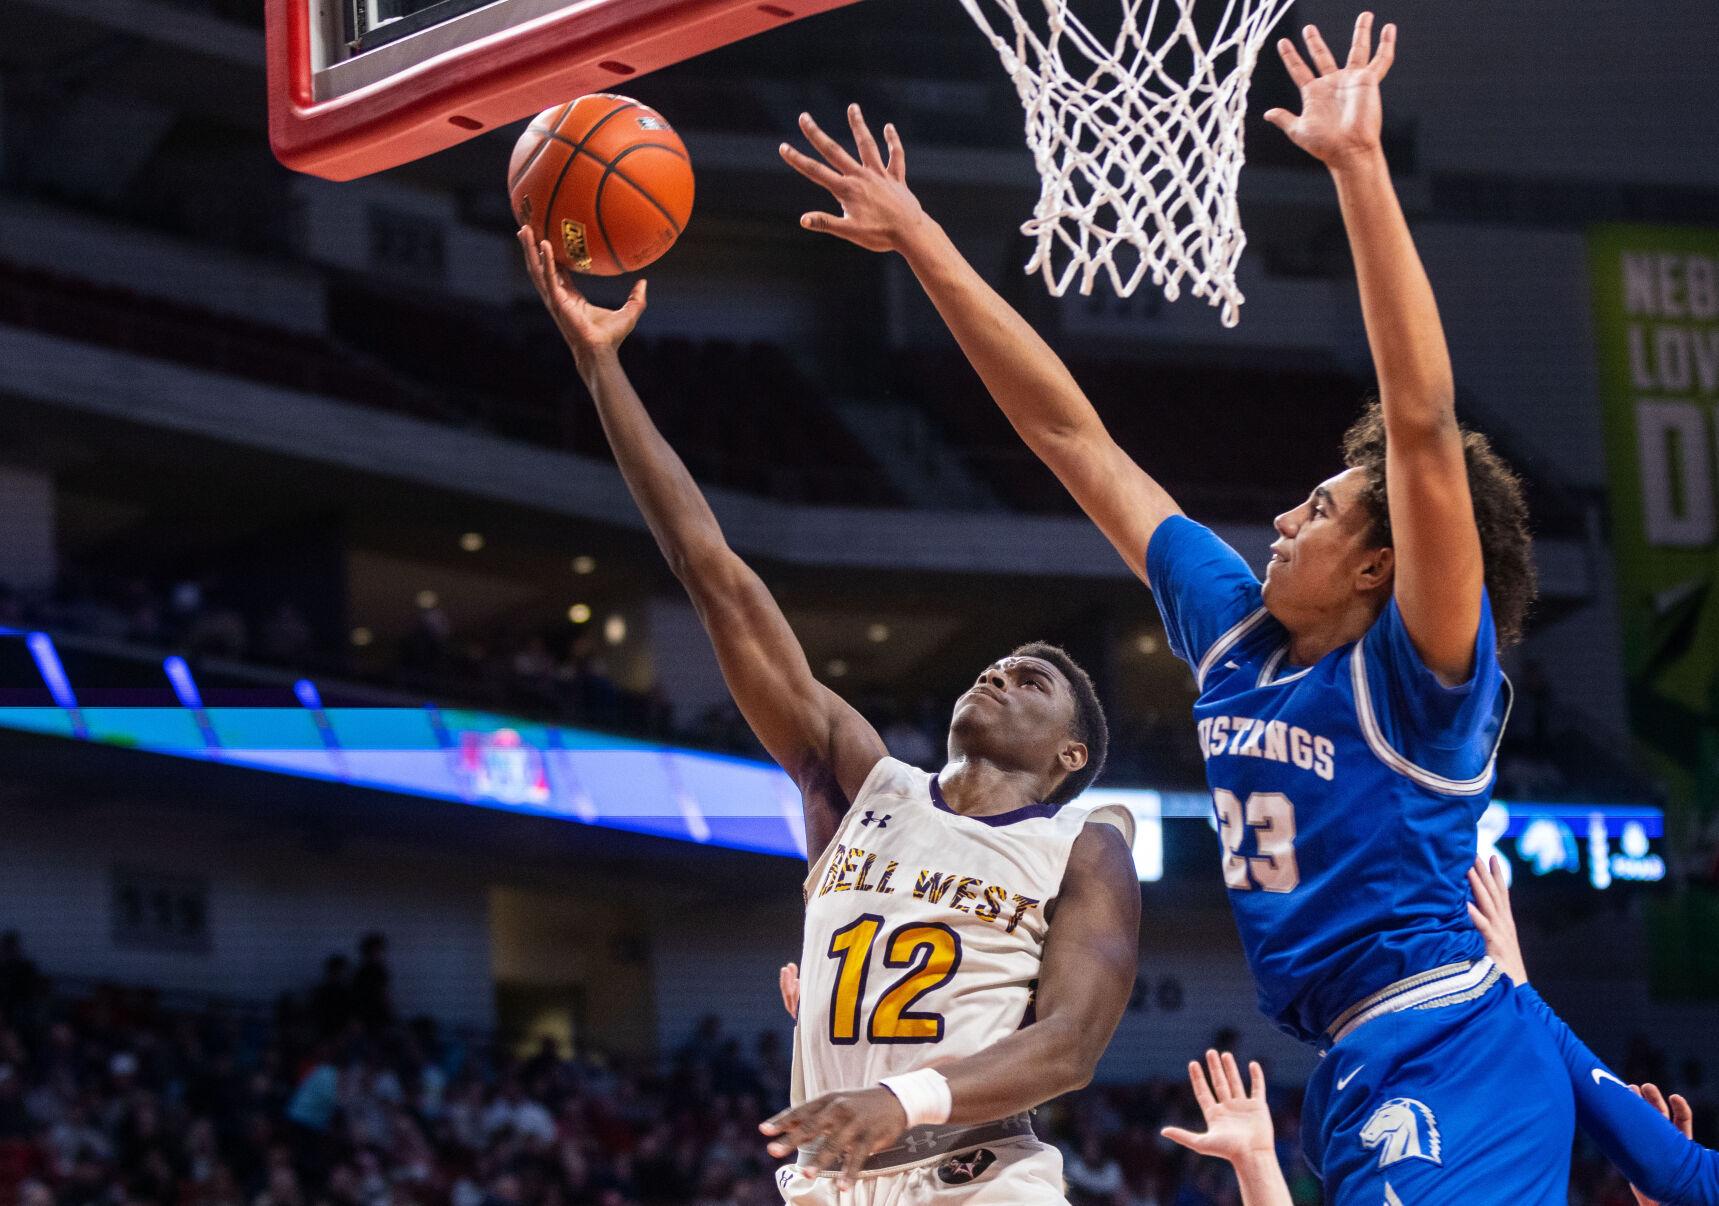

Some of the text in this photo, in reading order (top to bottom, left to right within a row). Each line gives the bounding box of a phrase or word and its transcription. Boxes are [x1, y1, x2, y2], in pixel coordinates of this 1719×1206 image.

[818, 843, 1041, 935] BELL WEST
[1213, 787, 1301, 894] 23
[826, 912, 963, 1046] 12
